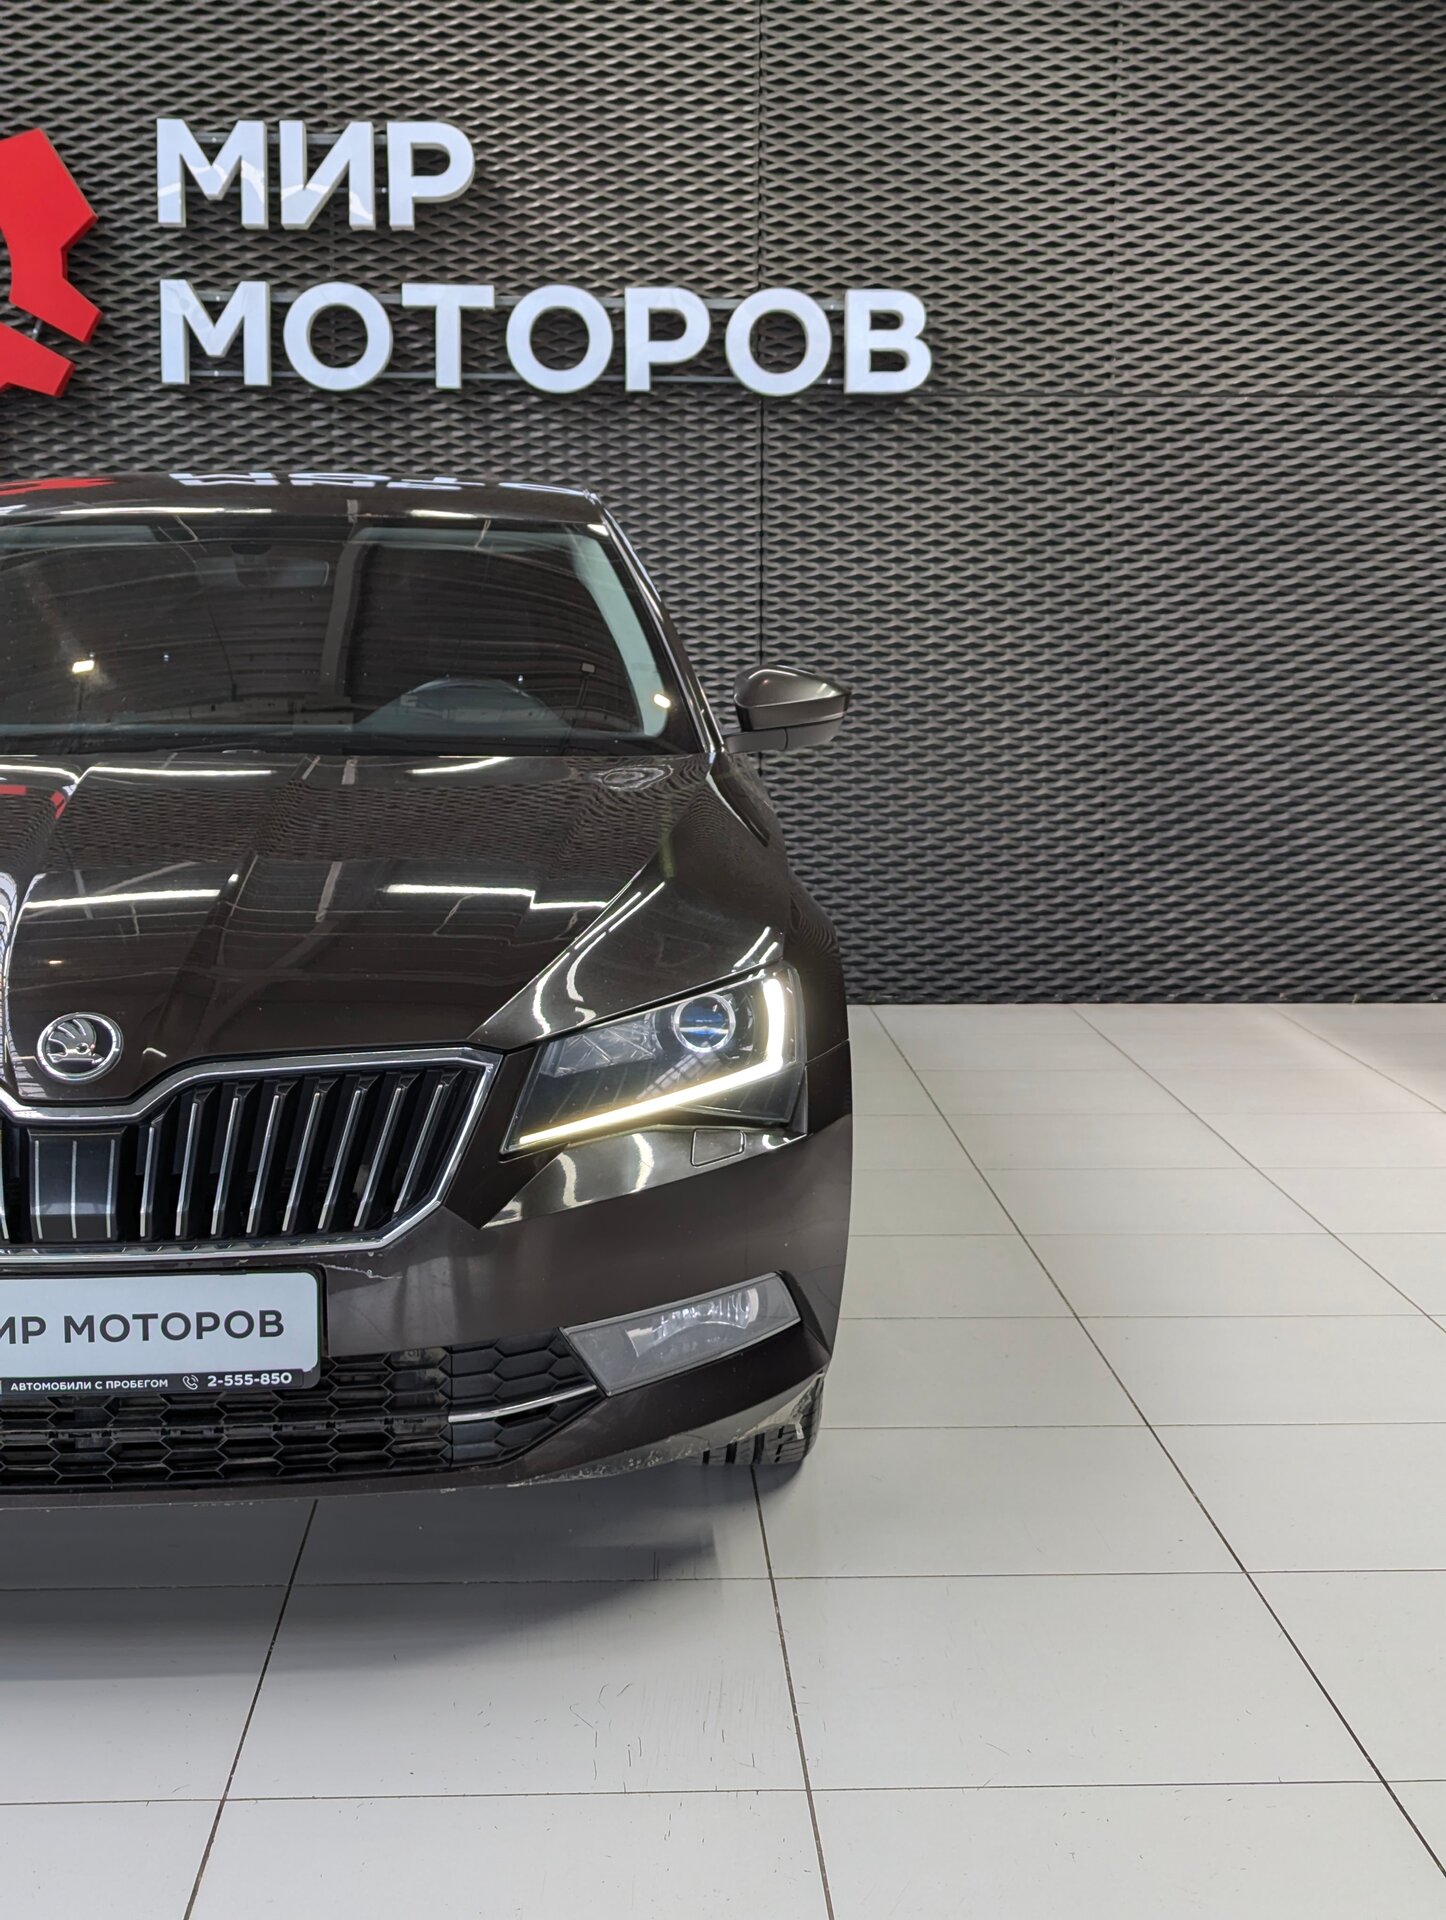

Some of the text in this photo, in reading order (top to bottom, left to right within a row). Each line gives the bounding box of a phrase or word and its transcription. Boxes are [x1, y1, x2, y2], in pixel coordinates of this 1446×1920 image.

[156, 118, 476, 230] МИР
[159, 279, 934, 395] МОТОРОВ
[63, 1309, 285, 1344] МОТОРОВ
[10, 1372, 292, 1392] АВТОМОБИЛИ С ПРОБЕГОМ 2-555-850
